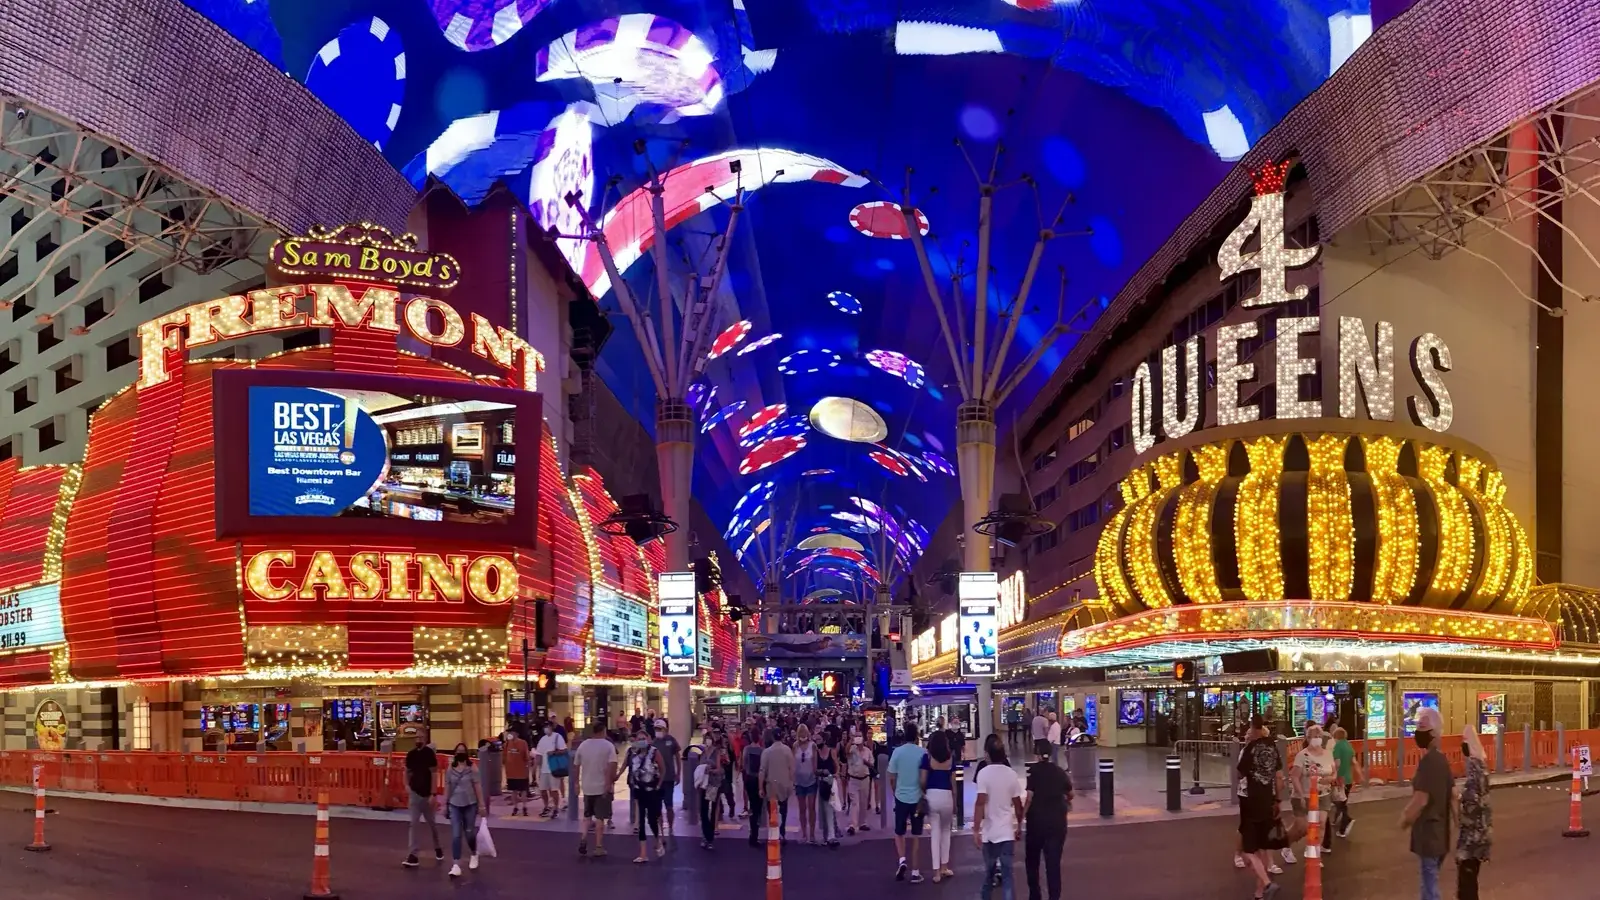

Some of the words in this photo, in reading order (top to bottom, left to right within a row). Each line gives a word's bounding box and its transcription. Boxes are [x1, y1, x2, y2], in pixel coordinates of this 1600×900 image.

[282, 240, 352, 268] Sam
[360, 247, 452, 280] Boyd's
[1218, 192, 1322, 308] 4
[136, 284, 546, 392] FREMONT
[1132, 316, 1453, 454] QUEENS
[274, 402, 334, 430] BEST
[274, 431, 297, 444] LAS
[300, 432, 340, 446] VEGAS
[244, 550, 519, 605] CASINO
[1, 632, 26, 648] $11.99
